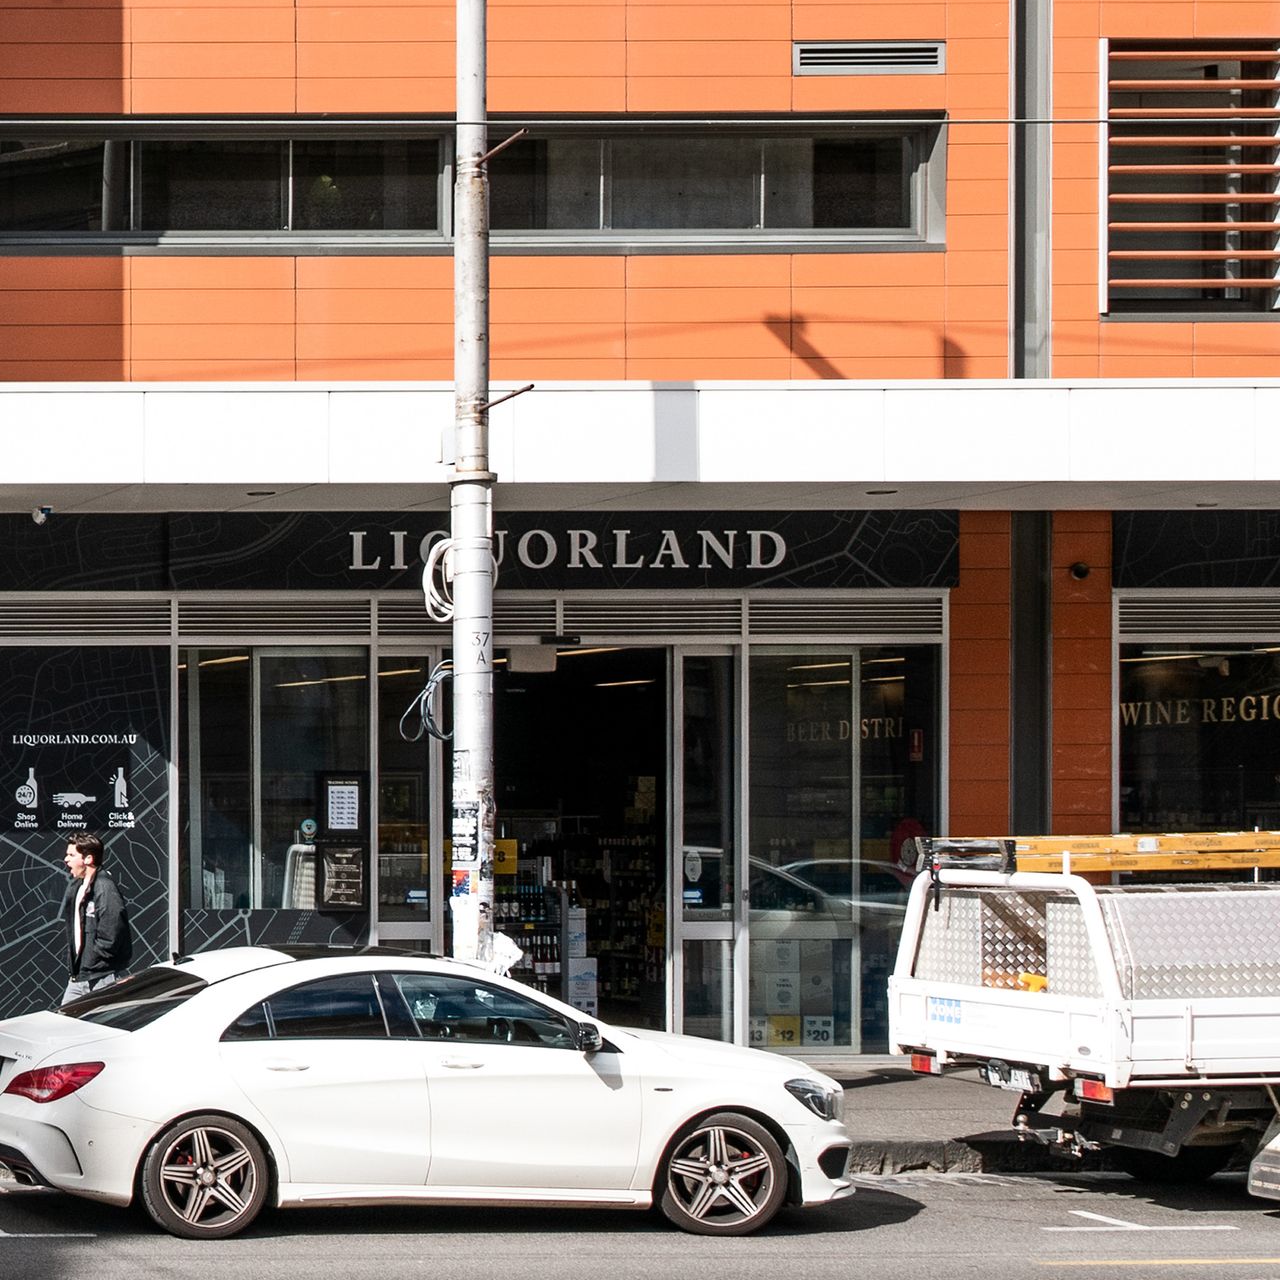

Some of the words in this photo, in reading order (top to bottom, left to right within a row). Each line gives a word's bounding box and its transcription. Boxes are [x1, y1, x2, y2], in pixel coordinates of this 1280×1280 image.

[472, 631, 490, 647] 37
[476, 650, 486, 665] A
[1120, 700, 1190, 726] WINE
[787, 720, 832, 742] BEER
[840, 717, 905, 741] DSTRI
[13, 734, 137, 746] LIQUORLAND.COM.AU
[17, 813, 36, 821] Shop
[57, 821, 87, 829] Delivery
[807, 1030, 829, 1041] $20
